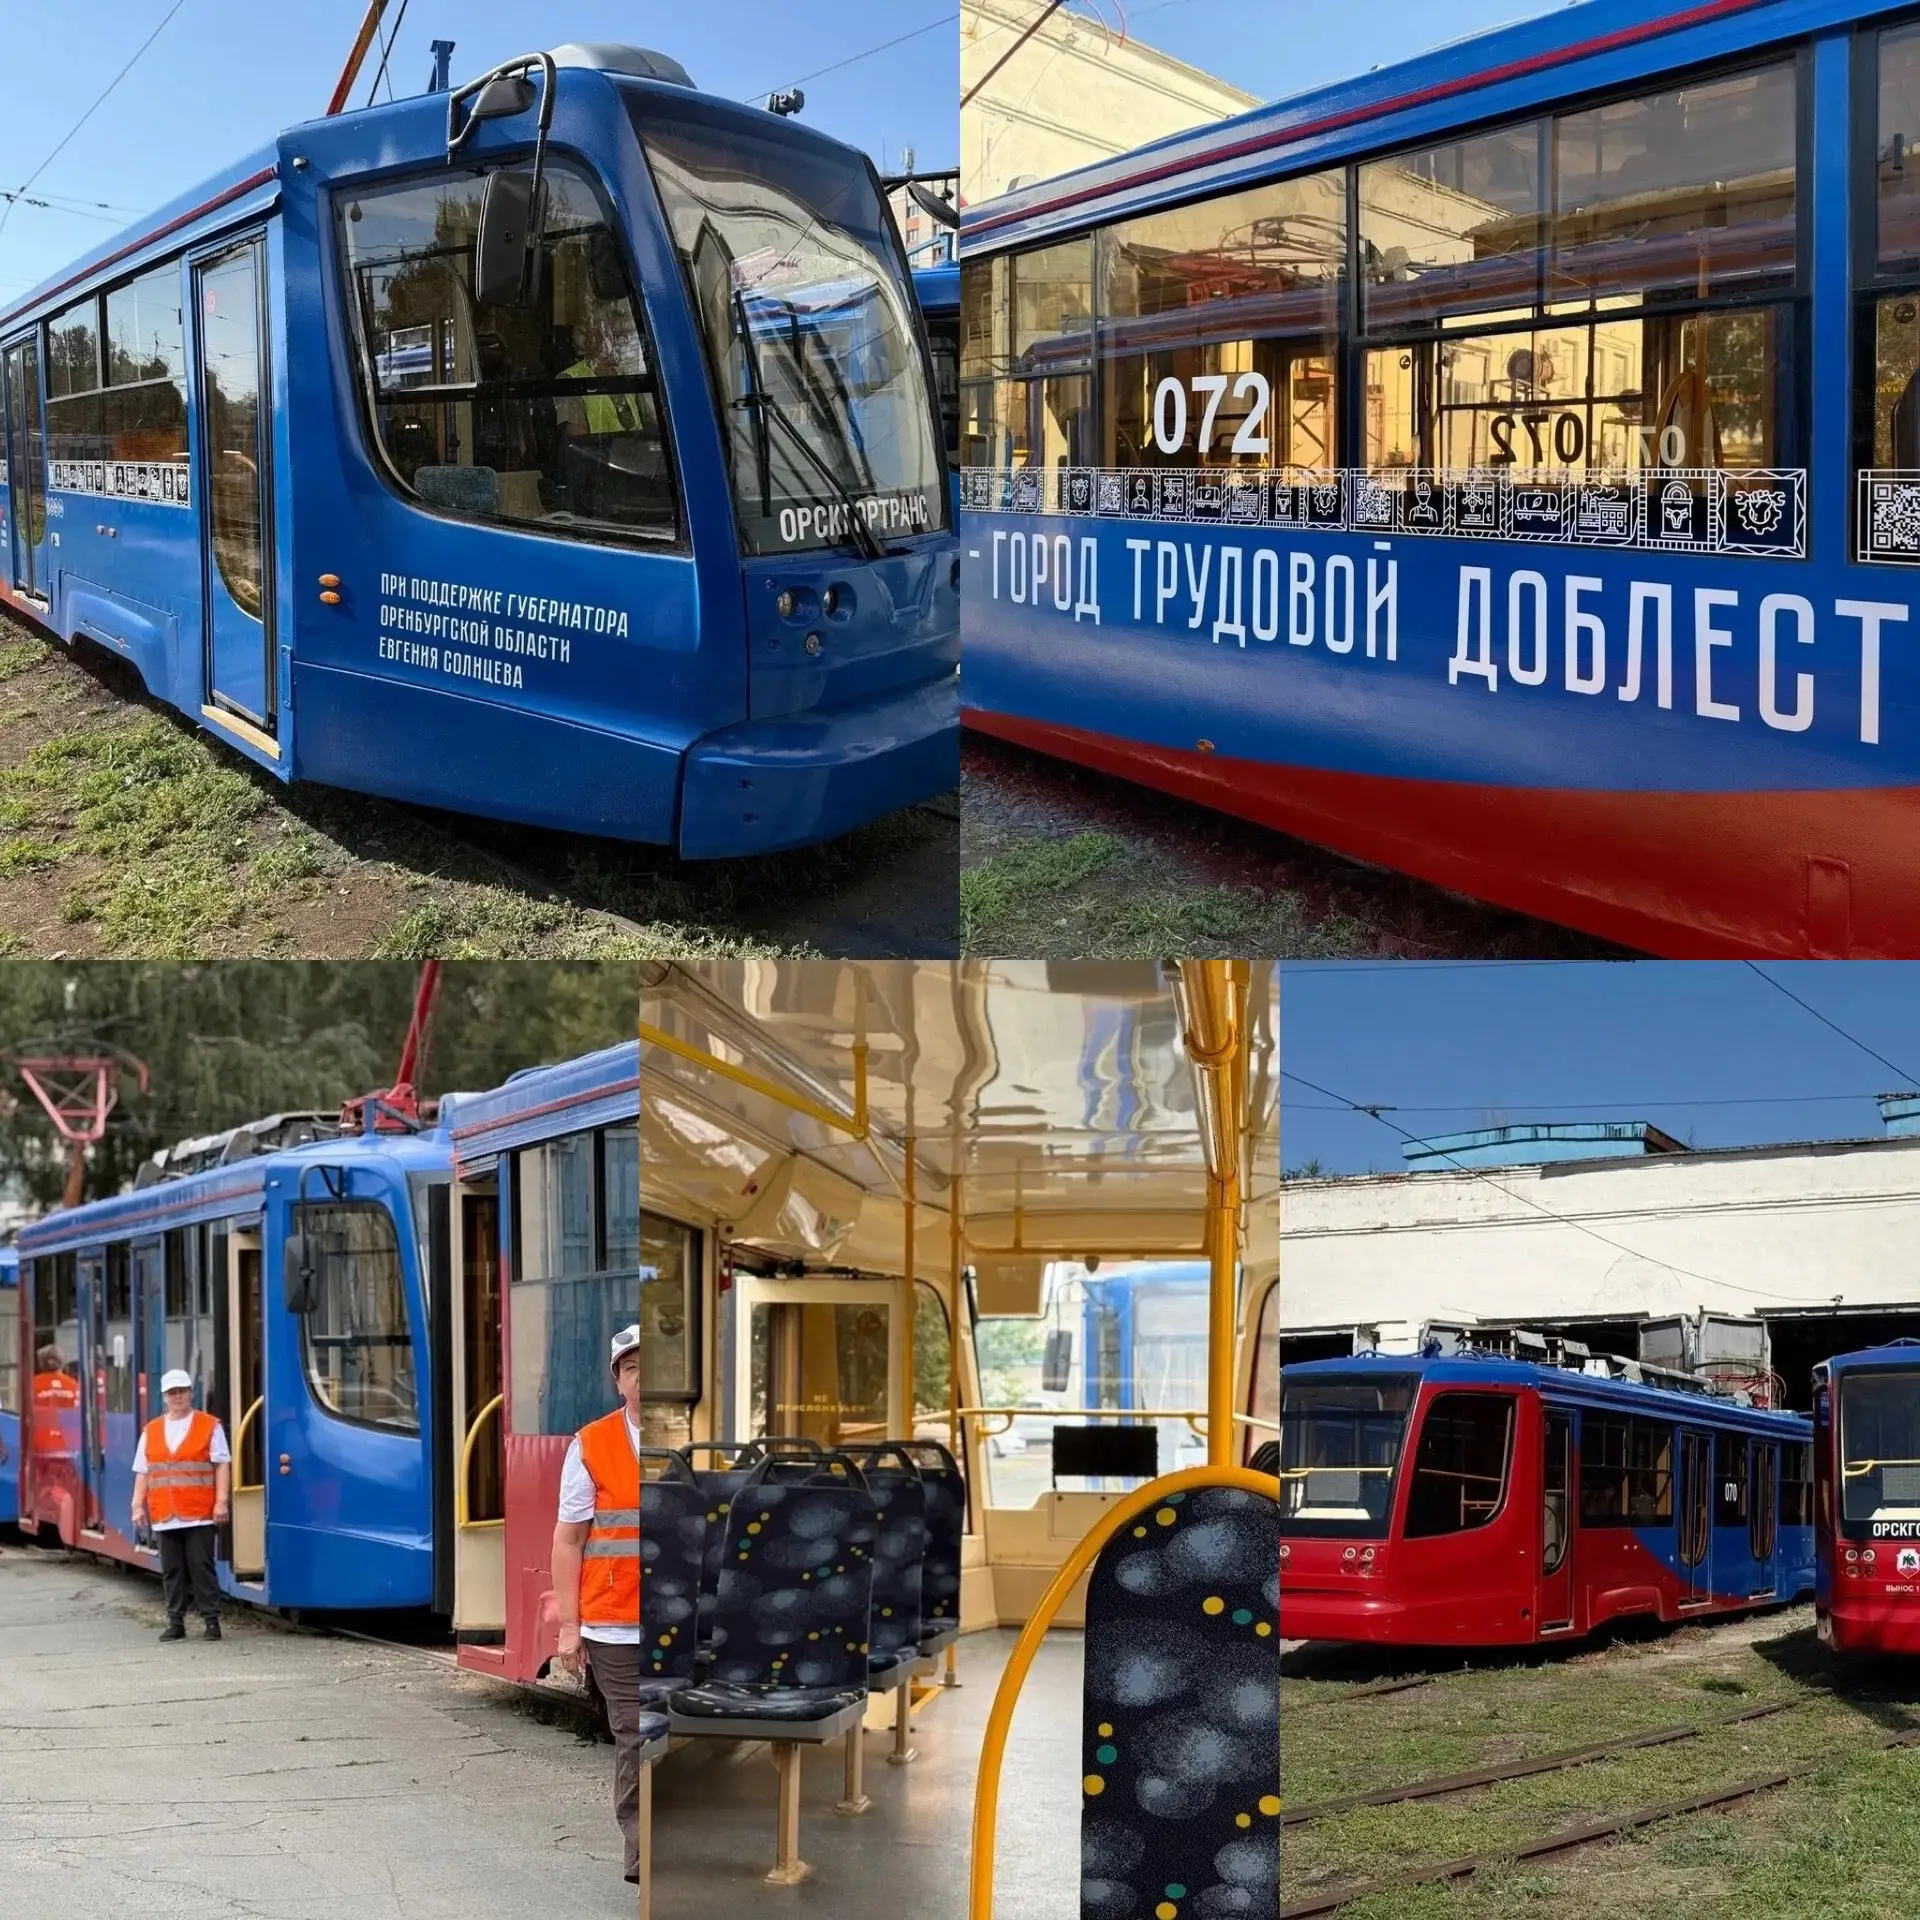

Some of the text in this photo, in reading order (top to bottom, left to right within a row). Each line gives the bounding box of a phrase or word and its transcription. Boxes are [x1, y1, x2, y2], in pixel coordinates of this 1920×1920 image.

[1154, 372, 1270, 455] 072
[380, 604, 570, 663] ОРЕНБУРГСКОЙ ОБЛАСТИ
[381, 573, 628, 638] ПРИ ПОДДЕРЖКЕ ГУБЕРНАТОРА
[379, 636, 523, 689] ЕВГЕНИЯ СОЛНЦЕВА
[993, 530, 1100, 625] ГОРОД
[1126, 538, 1398, 661] ТРУДОВОЙ
[1448, 565, 1909, 745] ДОБЛЕСТ
[1724, 1483, 1738, 1502] 070
[1885, 1584, 1914, 1593] ВЫНОС
